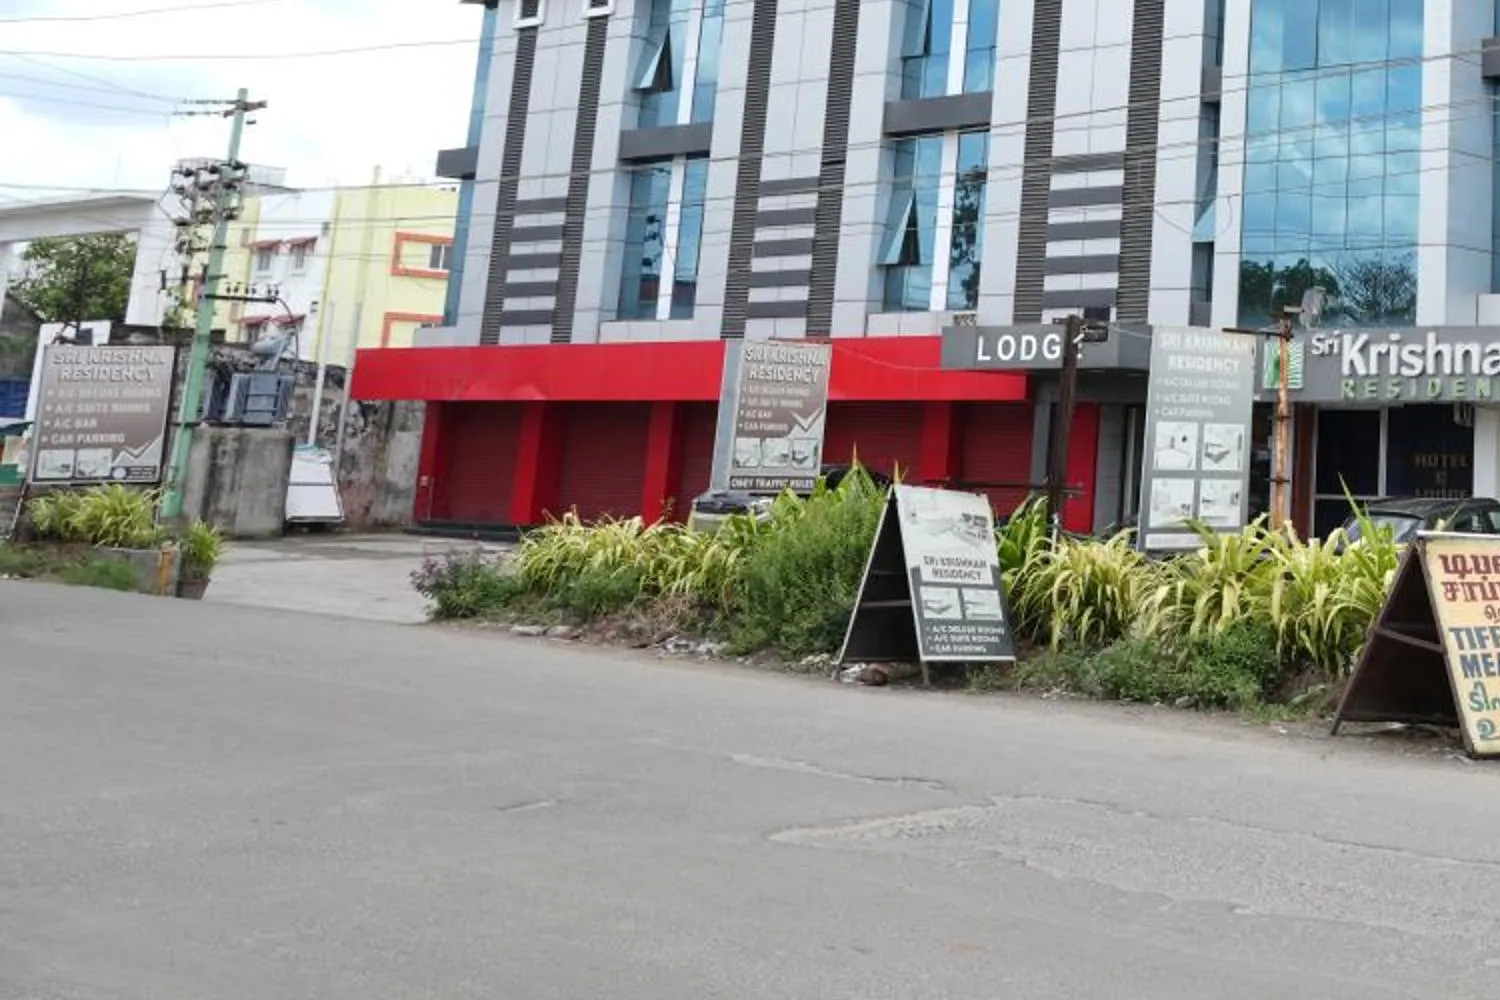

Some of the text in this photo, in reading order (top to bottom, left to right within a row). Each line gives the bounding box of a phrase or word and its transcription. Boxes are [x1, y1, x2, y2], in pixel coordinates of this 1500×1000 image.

[977, 333, 1083, 361] LODG
[1311, 330, 1341, 355] Sri
[60, 366, 156, 384] RESIDENCY
[749, 365, 820, 384] RESIDENCY
